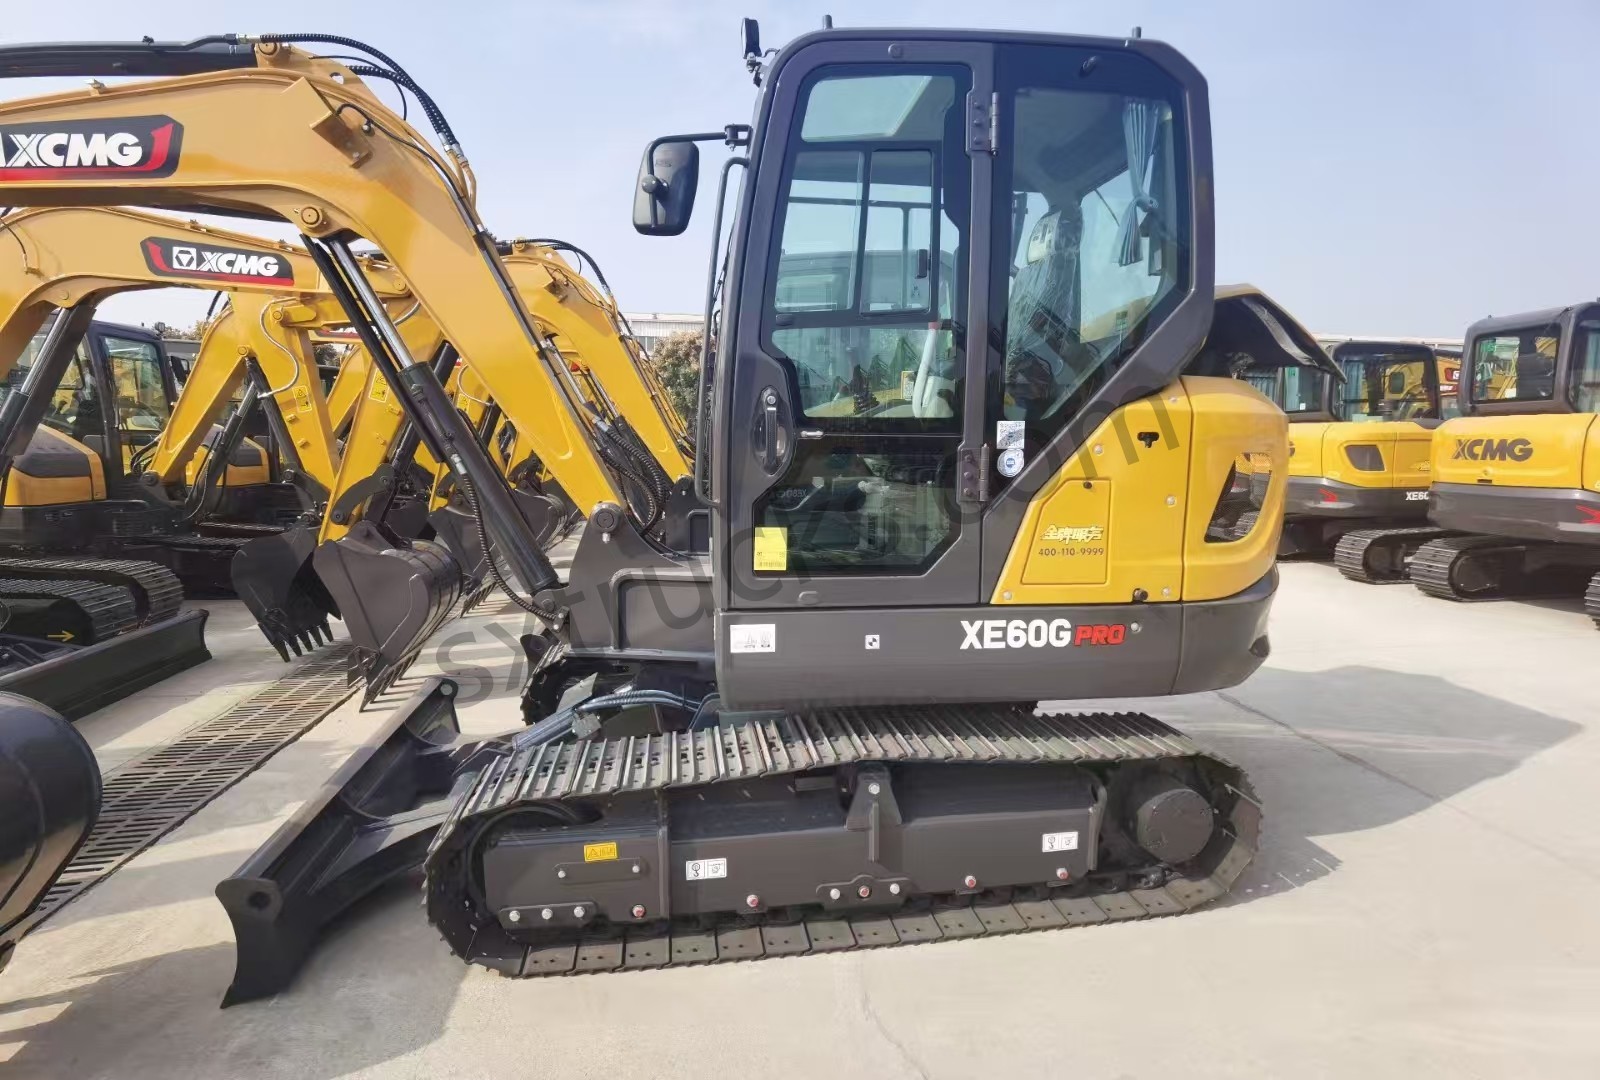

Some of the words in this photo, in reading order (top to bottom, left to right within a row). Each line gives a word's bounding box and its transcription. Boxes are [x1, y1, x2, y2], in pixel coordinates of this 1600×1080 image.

[7, 132, 143, 168] XCMG
[198, 251, 279, 277] XCMG
[1452, 438, 1534, 462] XCMG
[1038, 548, 1104, 556] 400-110-9999
[960, 618, 1071, 649] XE60G
[1074, 624, 1126, 646] PRO
